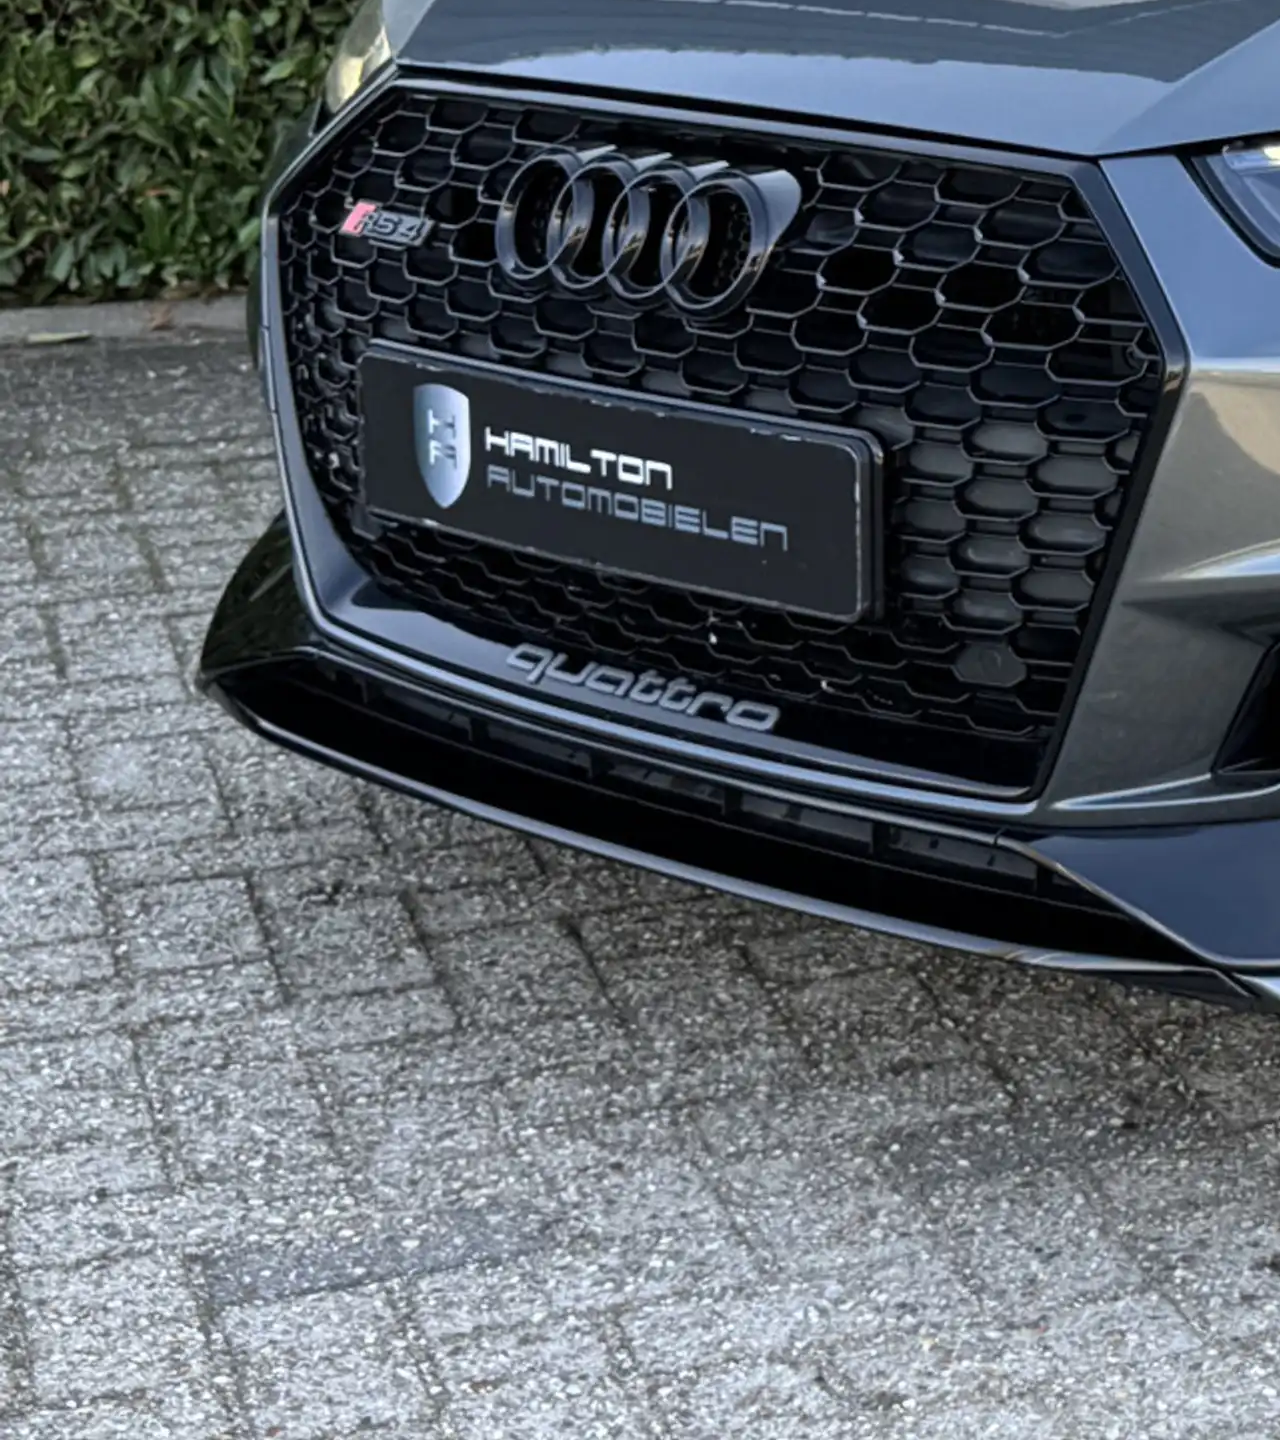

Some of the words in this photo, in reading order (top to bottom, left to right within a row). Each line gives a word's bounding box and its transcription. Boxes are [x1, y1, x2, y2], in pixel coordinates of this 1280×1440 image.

[484, 426, 673, 491] HAMILTON
[486, 464, 789, 552] AUTOMOBIELEN
[505, 641, 781, 732] quattro
